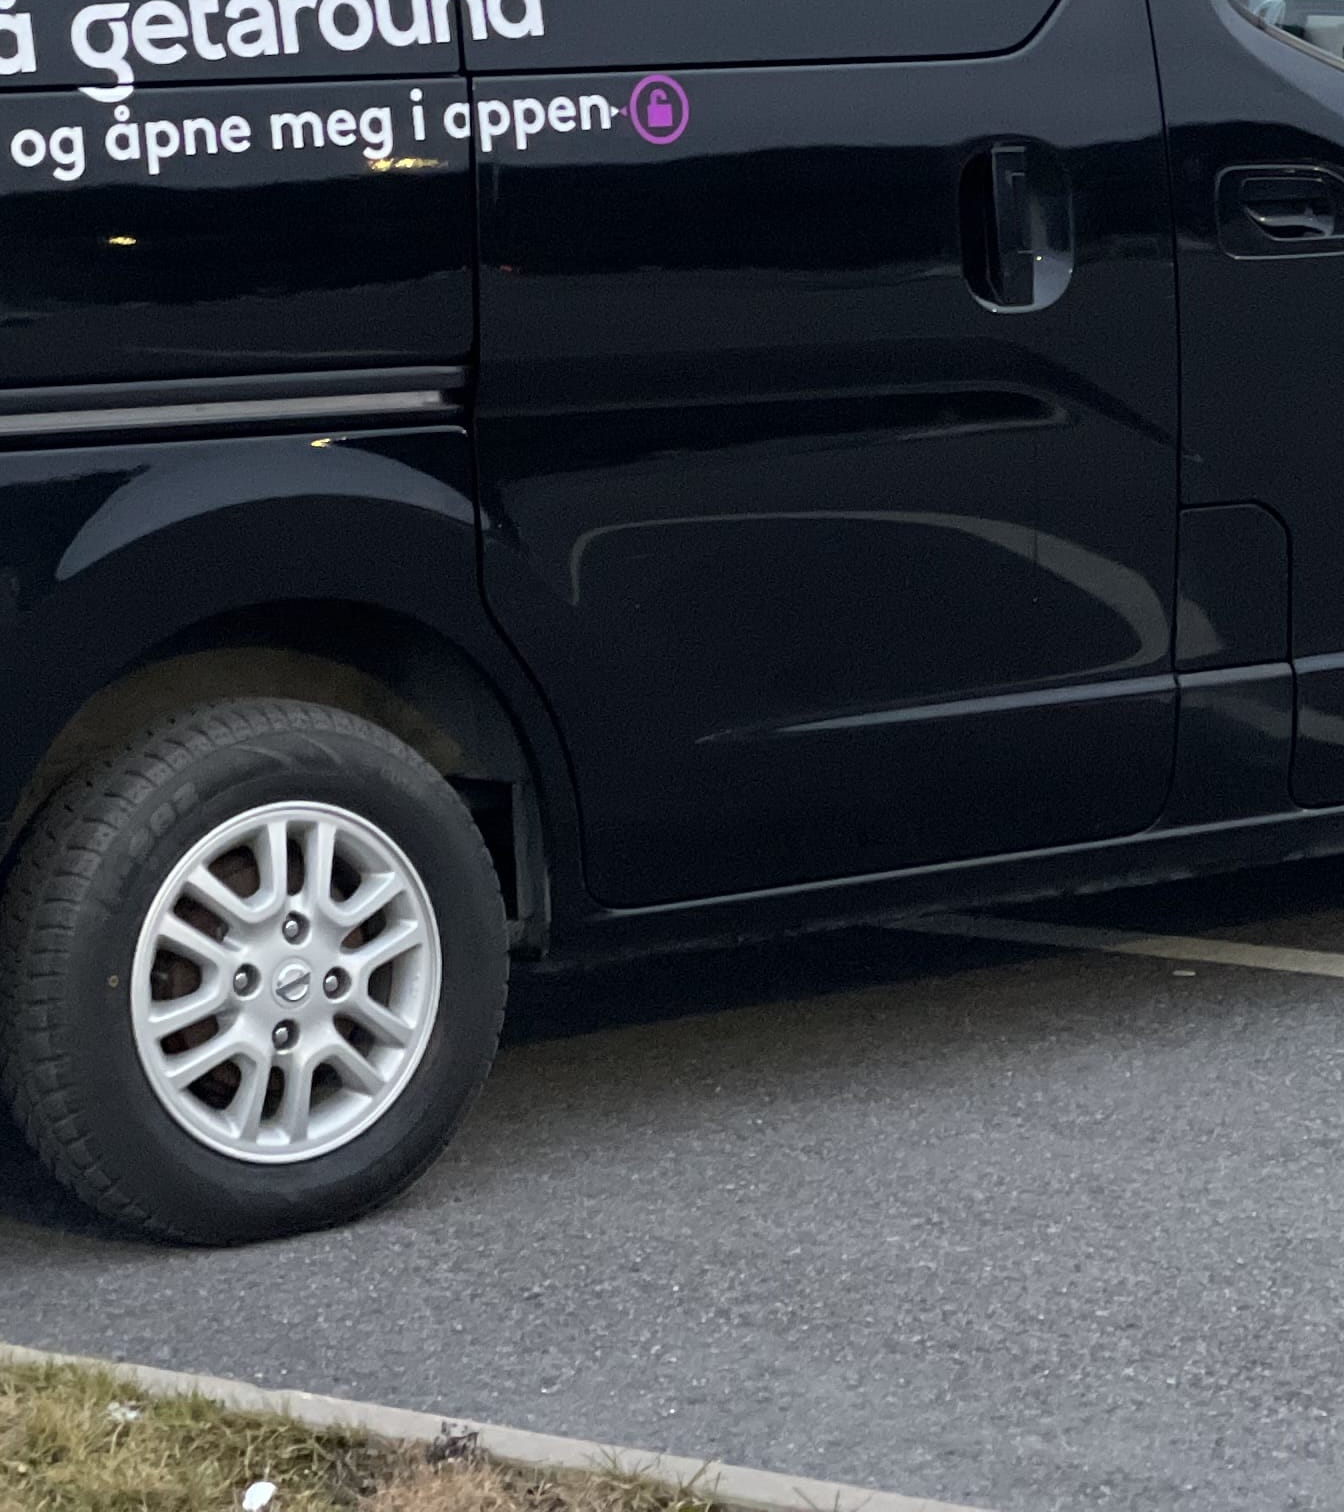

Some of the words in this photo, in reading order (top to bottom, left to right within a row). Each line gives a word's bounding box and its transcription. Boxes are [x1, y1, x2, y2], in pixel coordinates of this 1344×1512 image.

[10, 126, 86, 182] og
[104, 104, 252, 175] åpne
[270, 107, 395, 172] meg
[409, 88, 426, 141] i
[443, 94, 613, 154] appen
